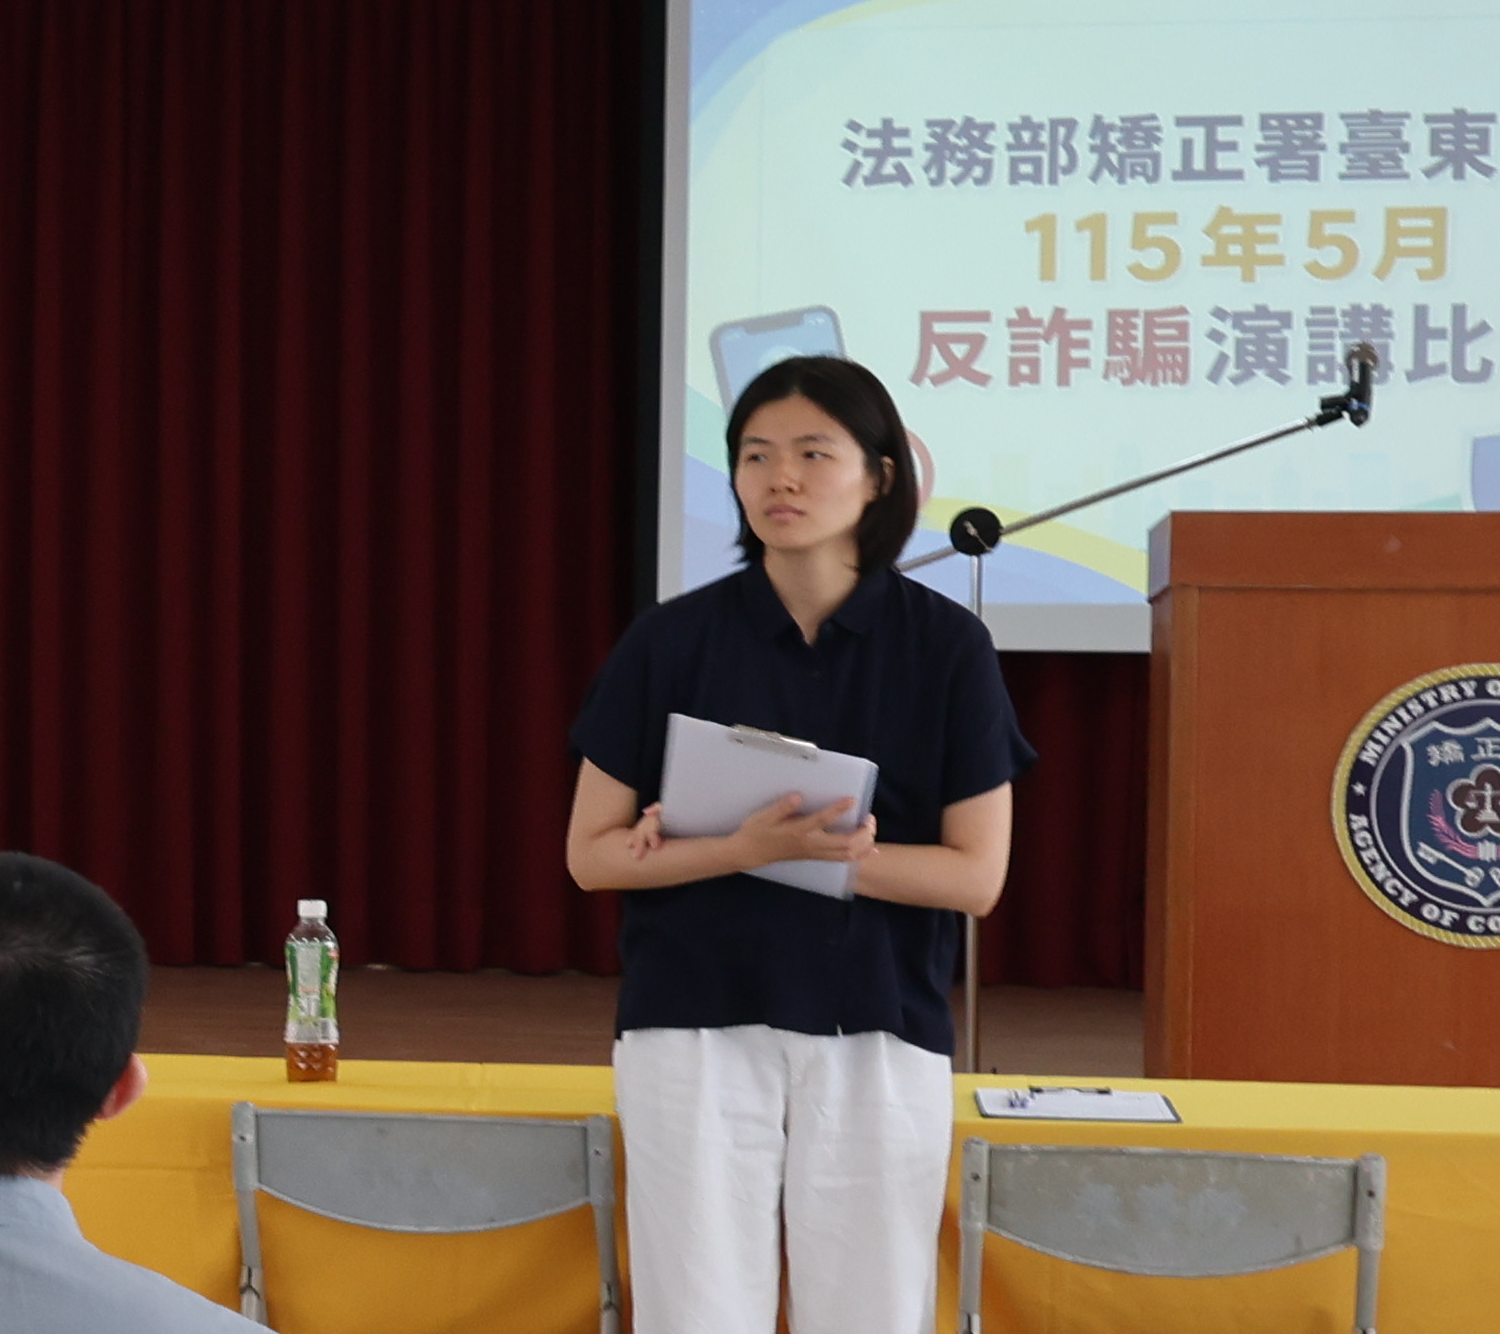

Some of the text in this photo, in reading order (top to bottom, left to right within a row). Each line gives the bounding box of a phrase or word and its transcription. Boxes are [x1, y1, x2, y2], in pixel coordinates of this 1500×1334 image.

[840, 108, 1498, 188] 法務部矯正署臺東
[1024, 204, 1449, 283] 115年5月
[909, 303, 1495, 387] 反詐騙演講比
[1358, 679, 1478, 767] MINISTRY
[1349, 813, 1419, 907] AGENCY
[1420, 903, 1460, 928] OF
